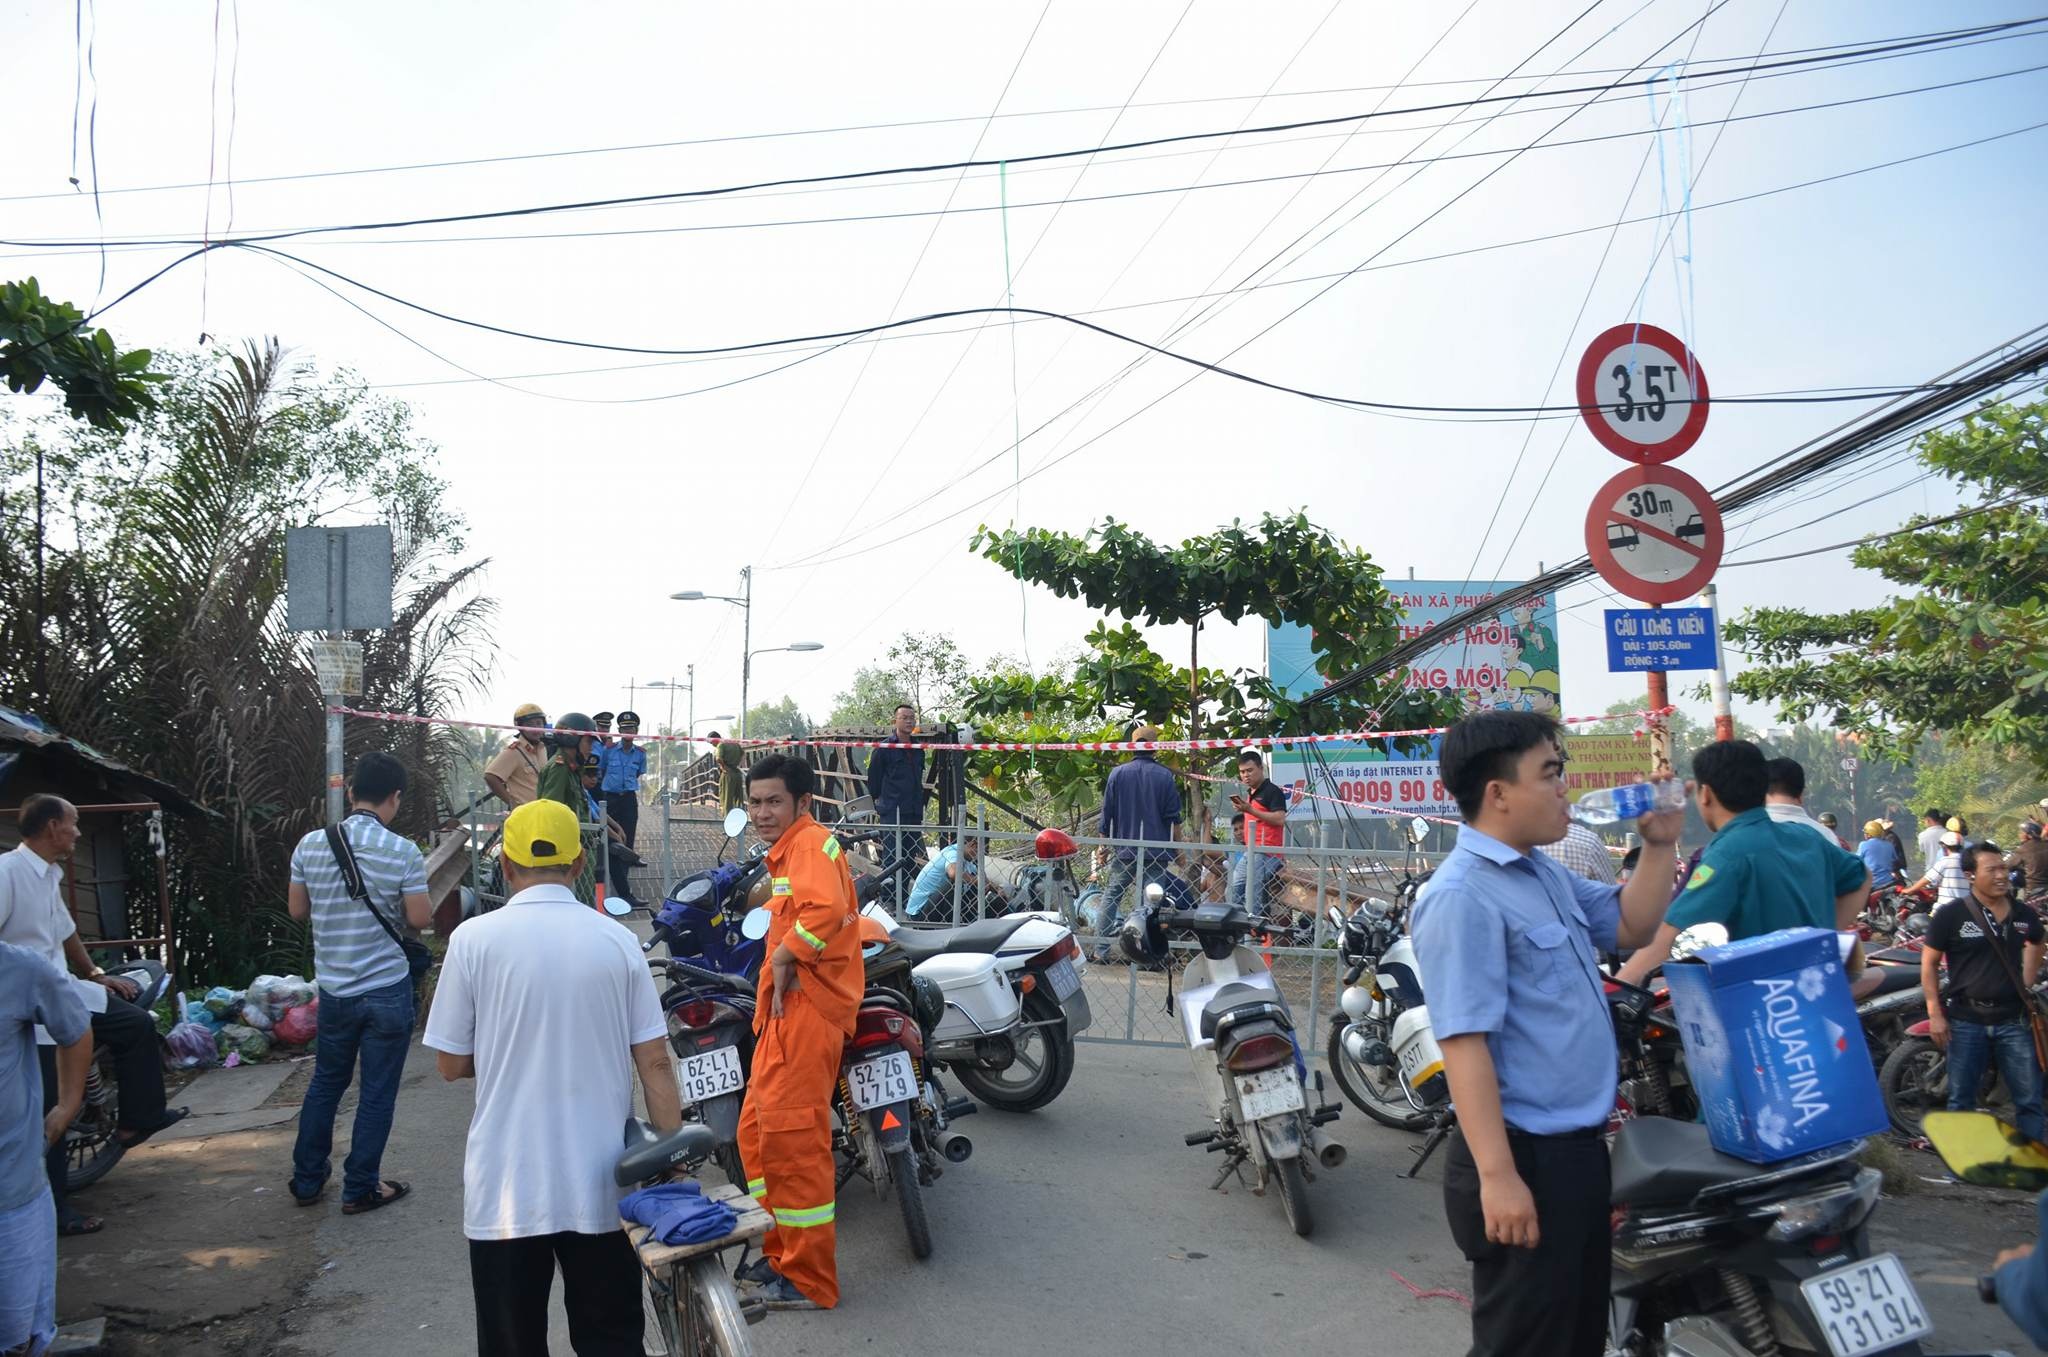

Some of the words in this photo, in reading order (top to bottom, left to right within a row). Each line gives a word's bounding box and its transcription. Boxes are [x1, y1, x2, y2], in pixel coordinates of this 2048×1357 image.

[1625, 490, 1673, 517] 30m
[1428, 592, 1450, 608] XÃ
[1614, 612, 1638, 636] CẦU
[1380, 766, 1423, 777] INTERNET
[1339, 780, 1393, 804] 0909
[1399, 780, 1426, 803] 90
[1403, 1043, 1424, 1072] CSTT
[1753, 979, 1830, 1127] AQUAFINA
[686, 1069, 741, 1100] 195.29
[854, 1057, 902, 1085] 52-Z6
[1819, 1264, 1893, 1314] 59-Z1
[1829, 1297, 1922, 1354] 131.94
